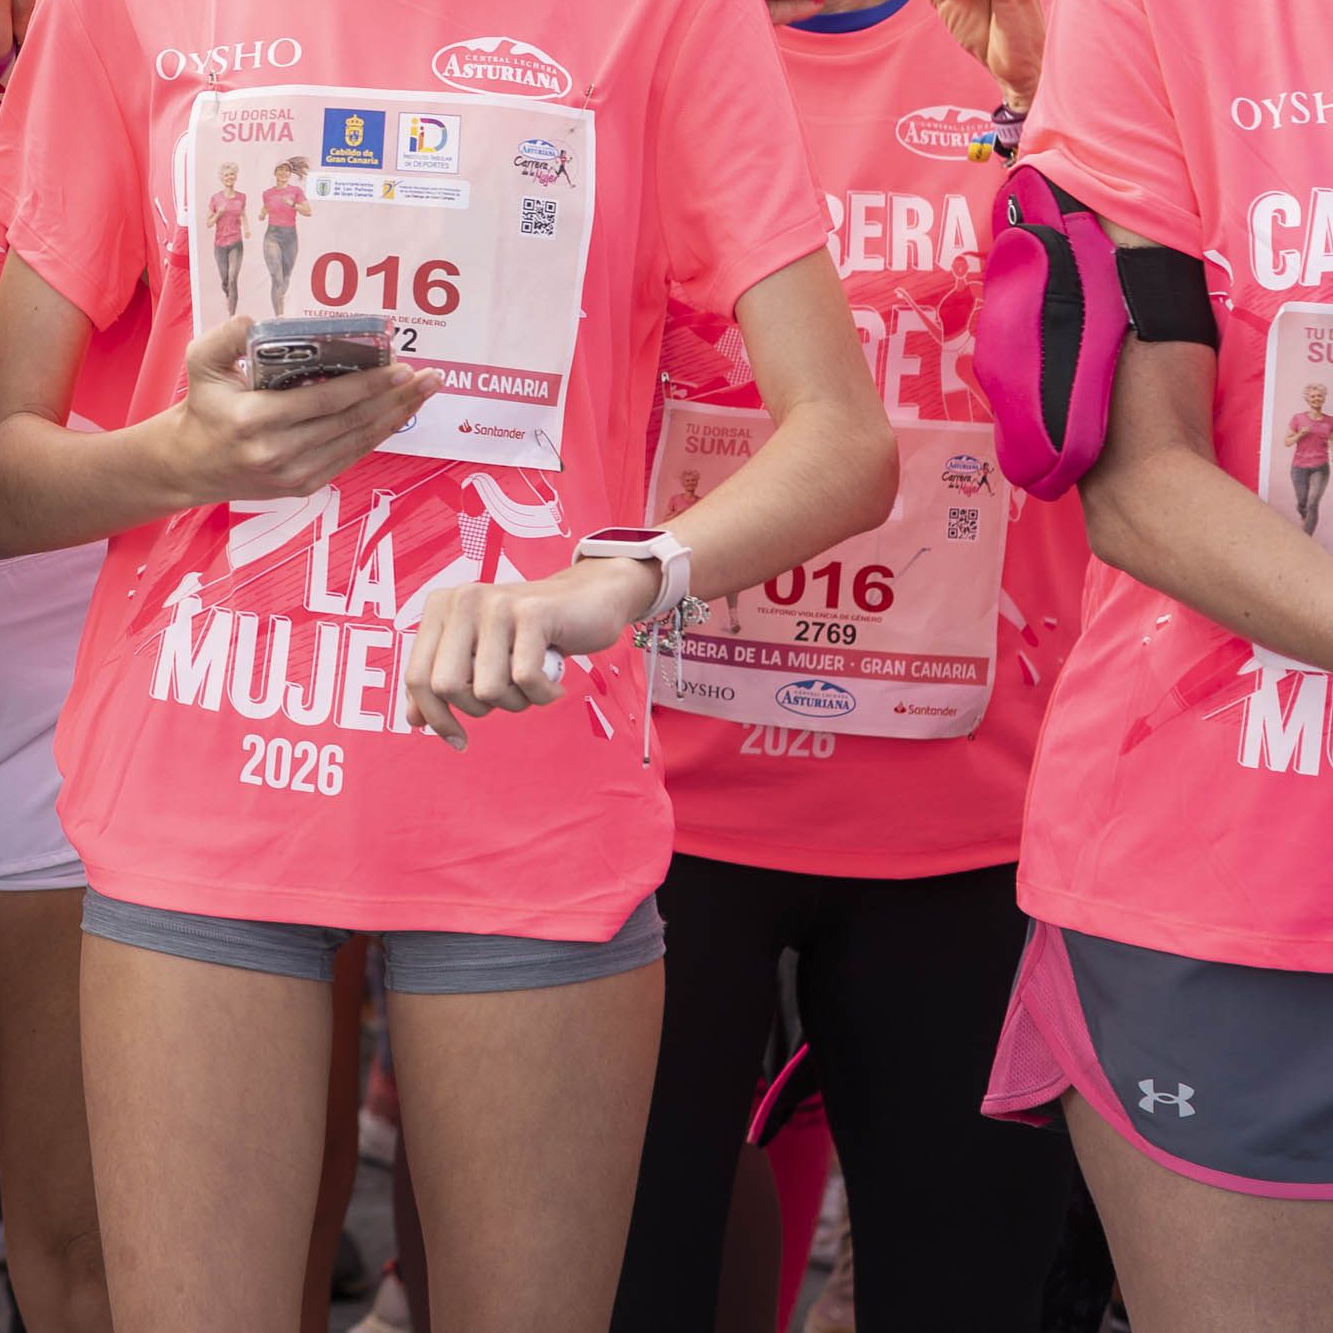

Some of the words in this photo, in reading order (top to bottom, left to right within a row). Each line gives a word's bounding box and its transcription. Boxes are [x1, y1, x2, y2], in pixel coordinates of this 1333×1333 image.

[155, 37, 303, 82] OYSHO
[464, 53, 509, 65] CENTRAL
[513, 58, 559, 75] LECHERA
[442, 52, 562, 93] ASTURIANA
[221, 110, 237, 123] TU
[241, 108, 295, 122] DORSAL
[221, 121, 294, 143] SUMA
[329, 148, 362, 156] Cabildo
[347, 156, 379, 164] Canaria
[514, 155, 549, 169] Carrera
[310, 252, 461, 316] 016
[411, 317, 447, 328] GÉNERO
[1305, 327, 1323, 341] TU
[477, 373, 550, 399] CANARIA
[474, 423, 526, 440] Santander
[685, 423, 700, 435] TU
[702, 423, 753, 439] DORSAL
[684, 436, 752, 458] SUMA
[304, 483, 398, 620] LA
[763, 561, 896, 614] 016
[756, 607, 797, 617] TELÉFONO
[797, 610, 839, 621] VIOLENCIA
[840, 614, 850, 622] DE
[850, 614, 883, 624] GÉNERO
[794, 620, 858, 646] 2769
[734, 645, 755, 664] DE
[760, 649, 782, 667] LA
[788, 651, 845, 672] MUJER
[860, 656, 906, 676] GRAN
[911, 659, 977, 680] CANARIA
[780, 691, 852, 712] ASTURIANA
[908, 703, 959, 718] Santander
[740, 723, 837, 759] 2026
[240, 735, 344, 797] 2026
